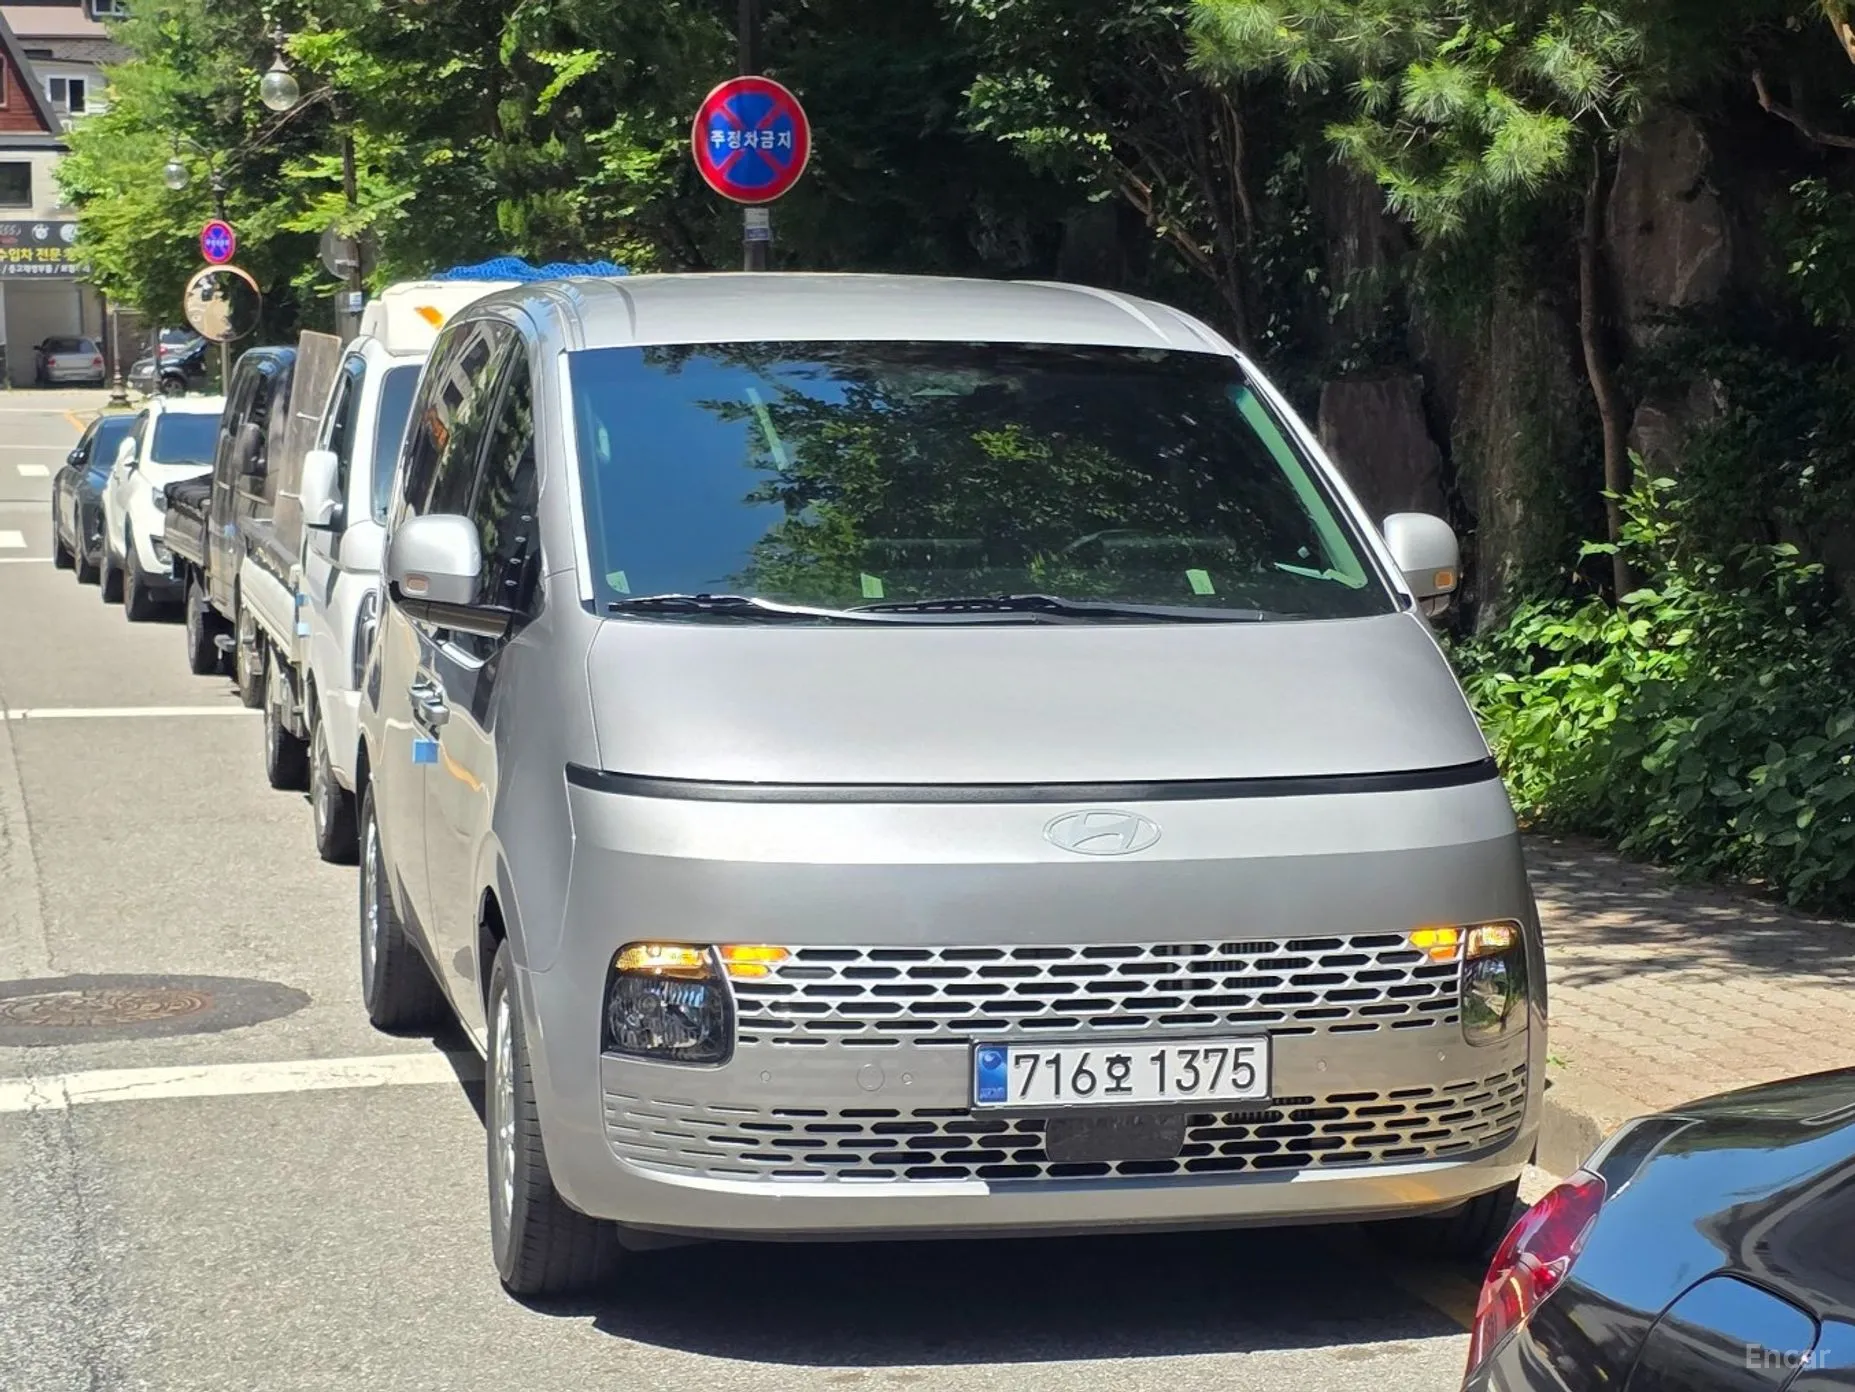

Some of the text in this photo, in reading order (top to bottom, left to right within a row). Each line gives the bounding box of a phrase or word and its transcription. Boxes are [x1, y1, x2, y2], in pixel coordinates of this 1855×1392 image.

[710, 130, 792, 149] 주정차금지
[36, 247, 62, 262] 전문
[1014, 1046, 1256, 1098] 716호 1375
